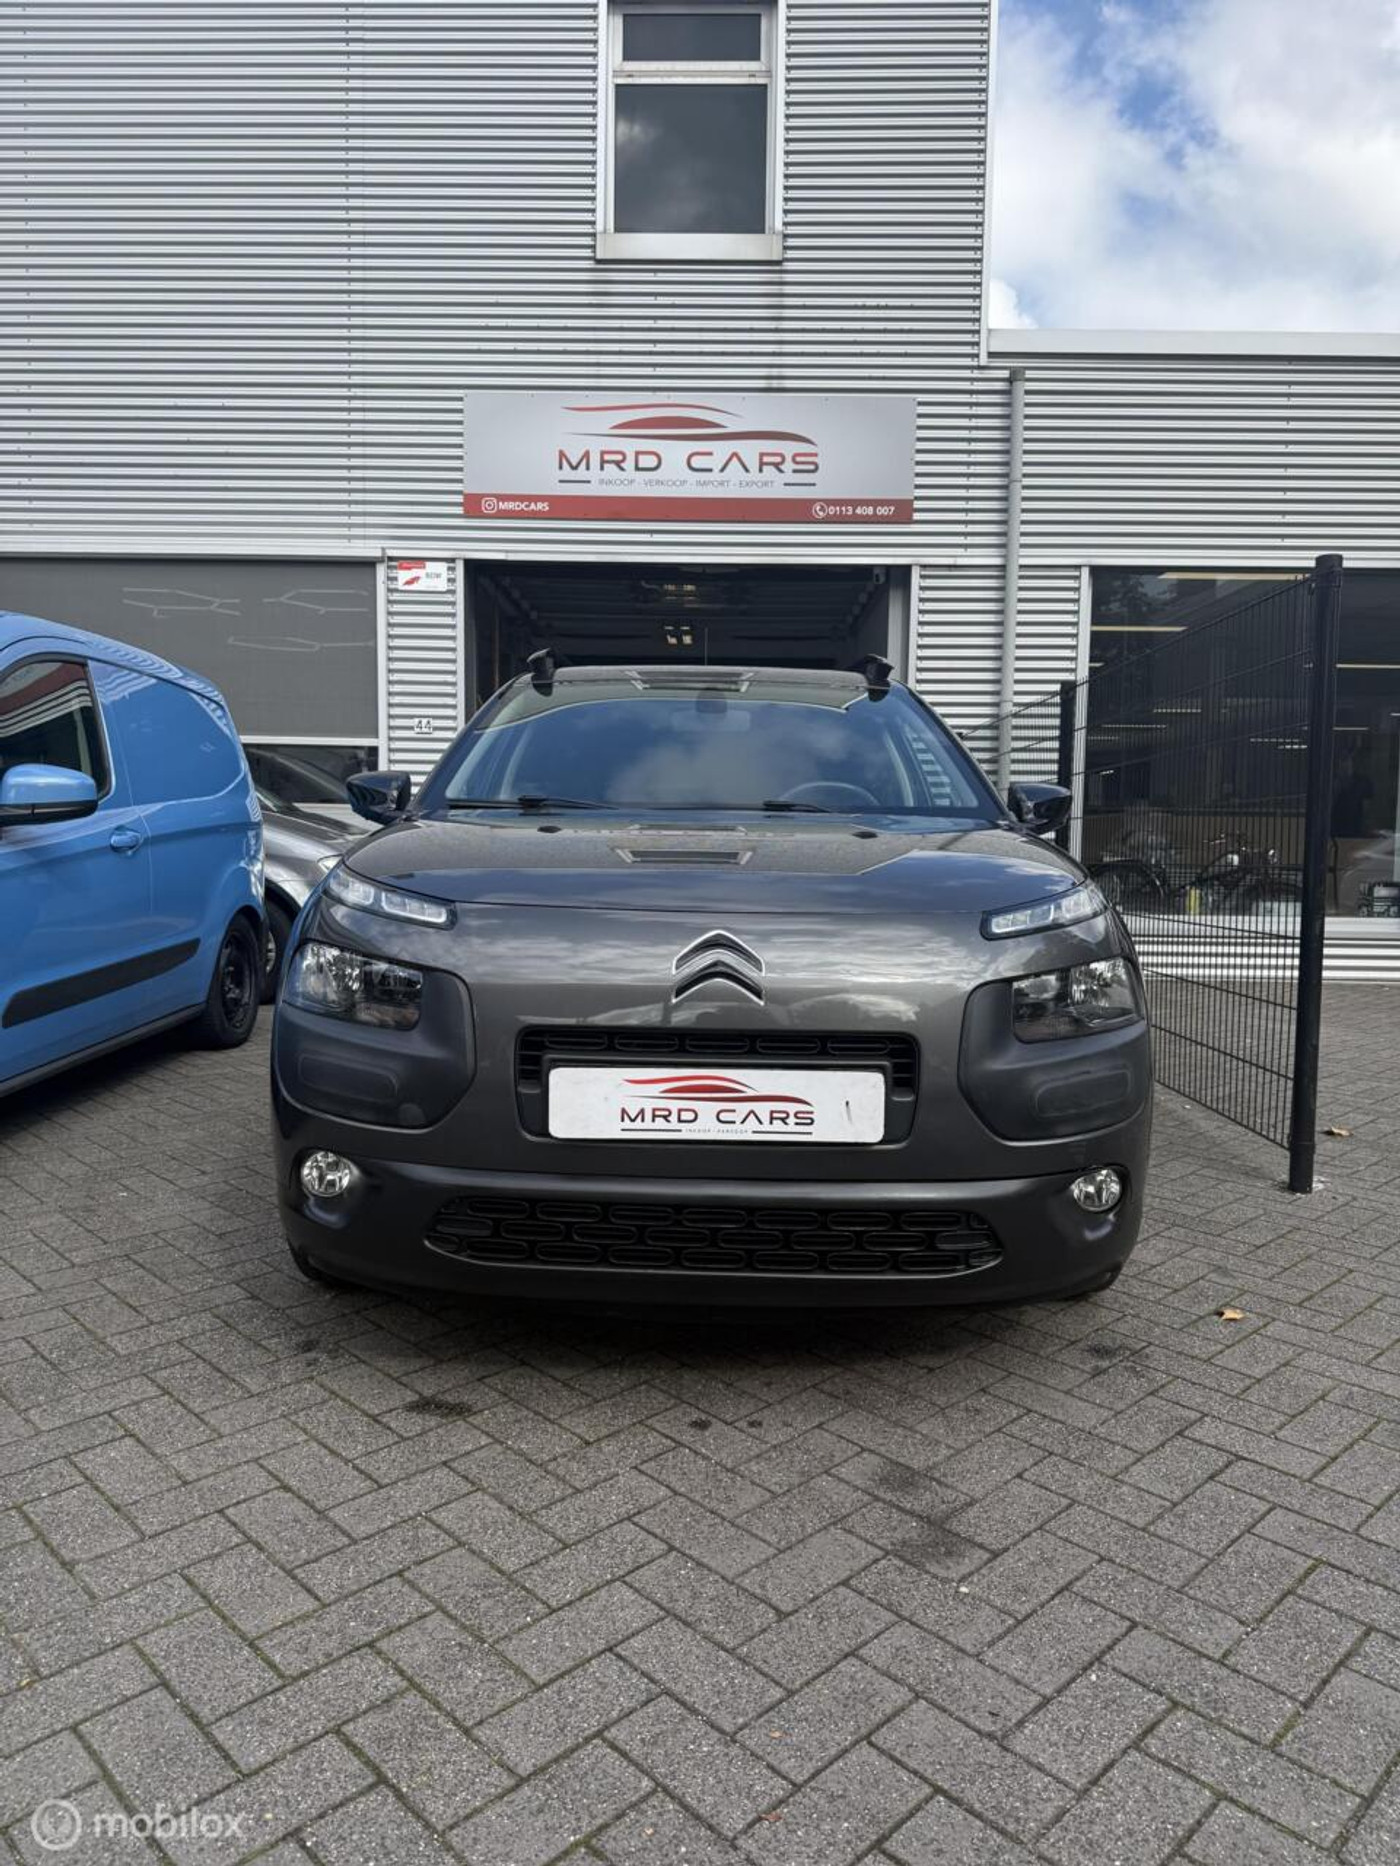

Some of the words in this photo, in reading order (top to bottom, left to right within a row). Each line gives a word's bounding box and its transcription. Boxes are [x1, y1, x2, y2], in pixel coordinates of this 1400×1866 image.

[558, 449, 662, 472] MRD
[686, 451, 819, 474] CARS
[598, 478, 635, 487] INKOOP
[643, 478, 688, 488] VERKOOP
[695, 479, 730, 489] IMPORT
[738, 479, 774, 489] EXPORT
[499, 501, 550, 512] MRDCARS
[828, 505, 853, 515] 0113
[855, 505, 874, 515] 408
[876, 505, 895, 516] 007
[415, 718, 431, 729] 44
[620, 1107, 698, 1123] MRD
[715, 1109, 815, 1126] CARS
